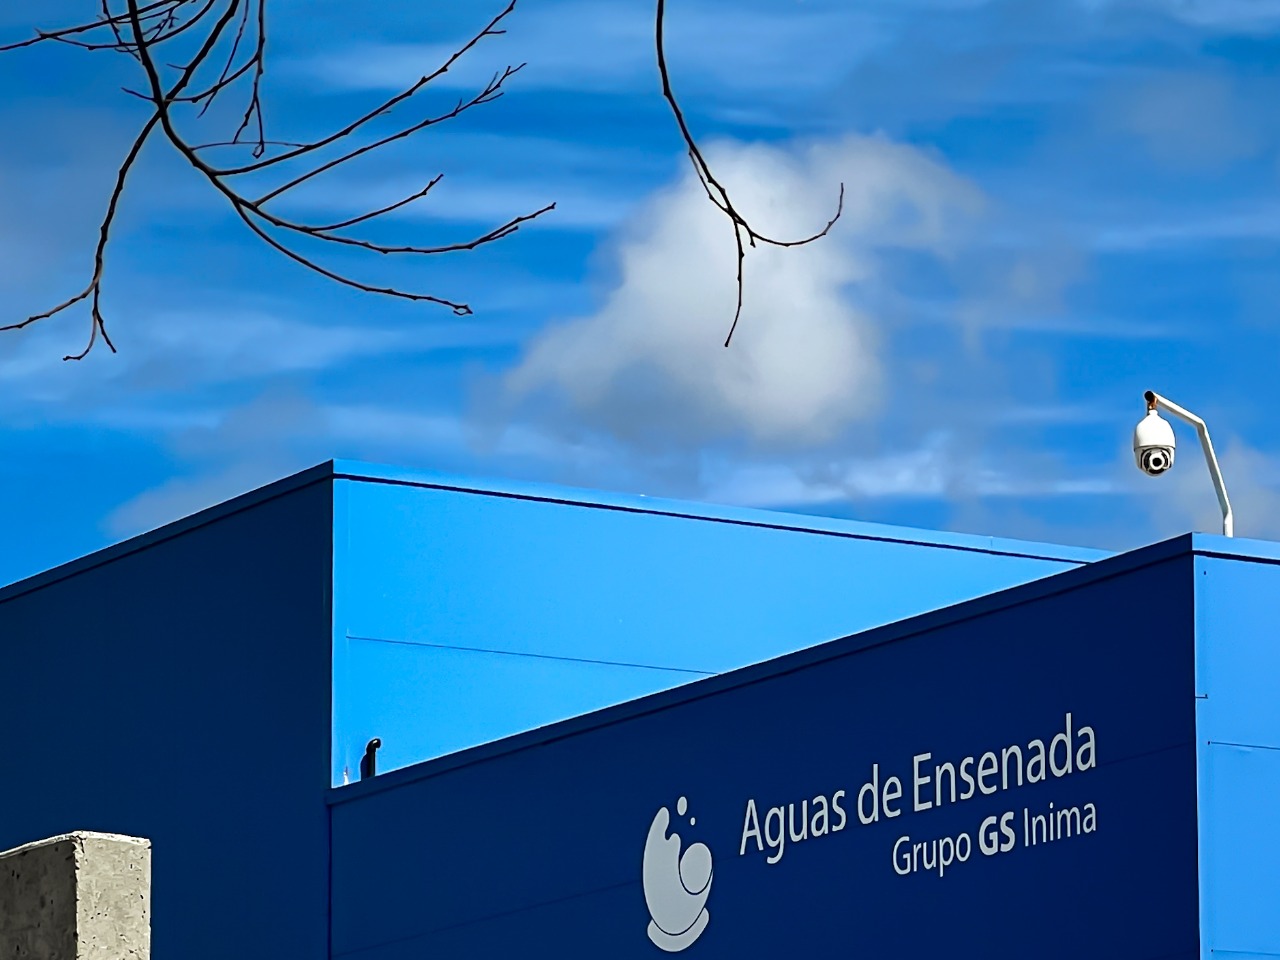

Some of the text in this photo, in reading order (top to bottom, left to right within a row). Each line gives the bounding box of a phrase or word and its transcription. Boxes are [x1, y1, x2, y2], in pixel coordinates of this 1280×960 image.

[740, 712, 1097, 865] Aguas de Ensenada
[892, 801, 1097, 878] Grupo GS Inima
